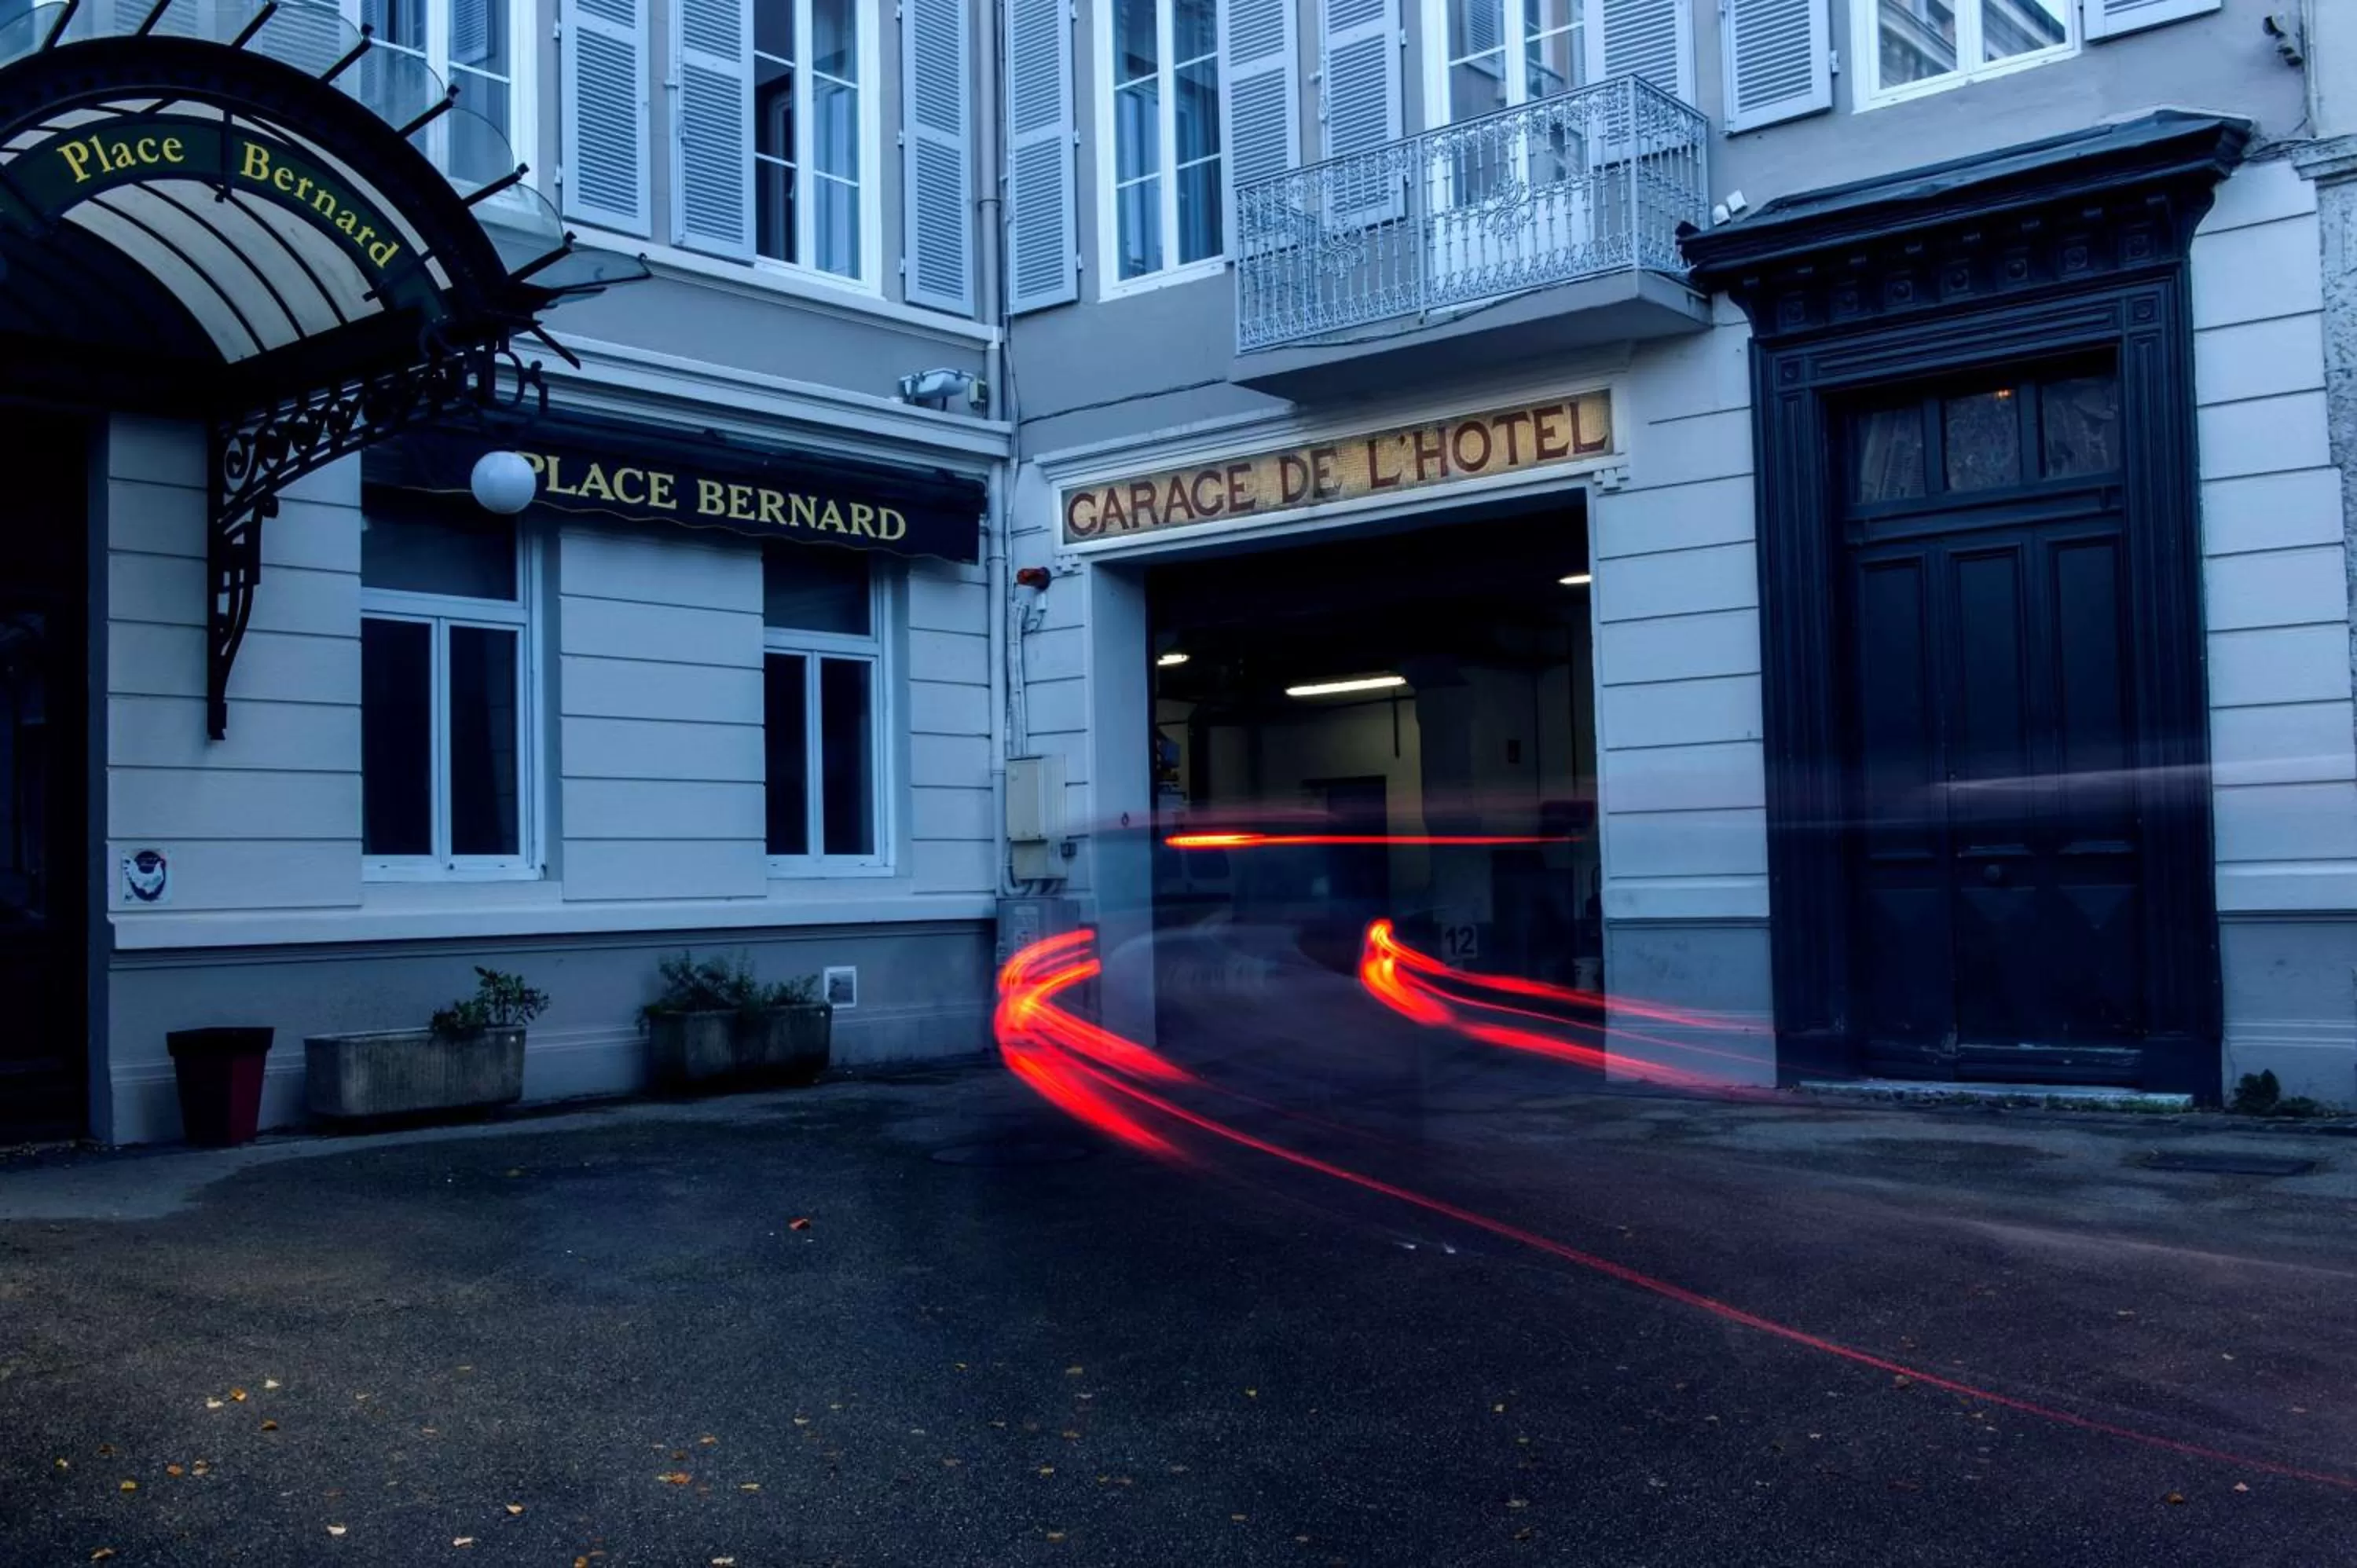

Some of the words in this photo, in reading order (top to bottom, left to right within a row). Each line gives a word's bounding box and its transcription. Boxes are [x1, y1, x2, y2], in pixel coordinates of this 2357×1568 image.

[57, 134, 185, 182] Place
[240, 141, 400, 269] Bernard
[697, 478, 907, 541] BERNARD
[1067, 463, 1256, 537] GARAGE
[1278, 447, 1343, 504] DE
[1446, 926, 1475, 956] 12
